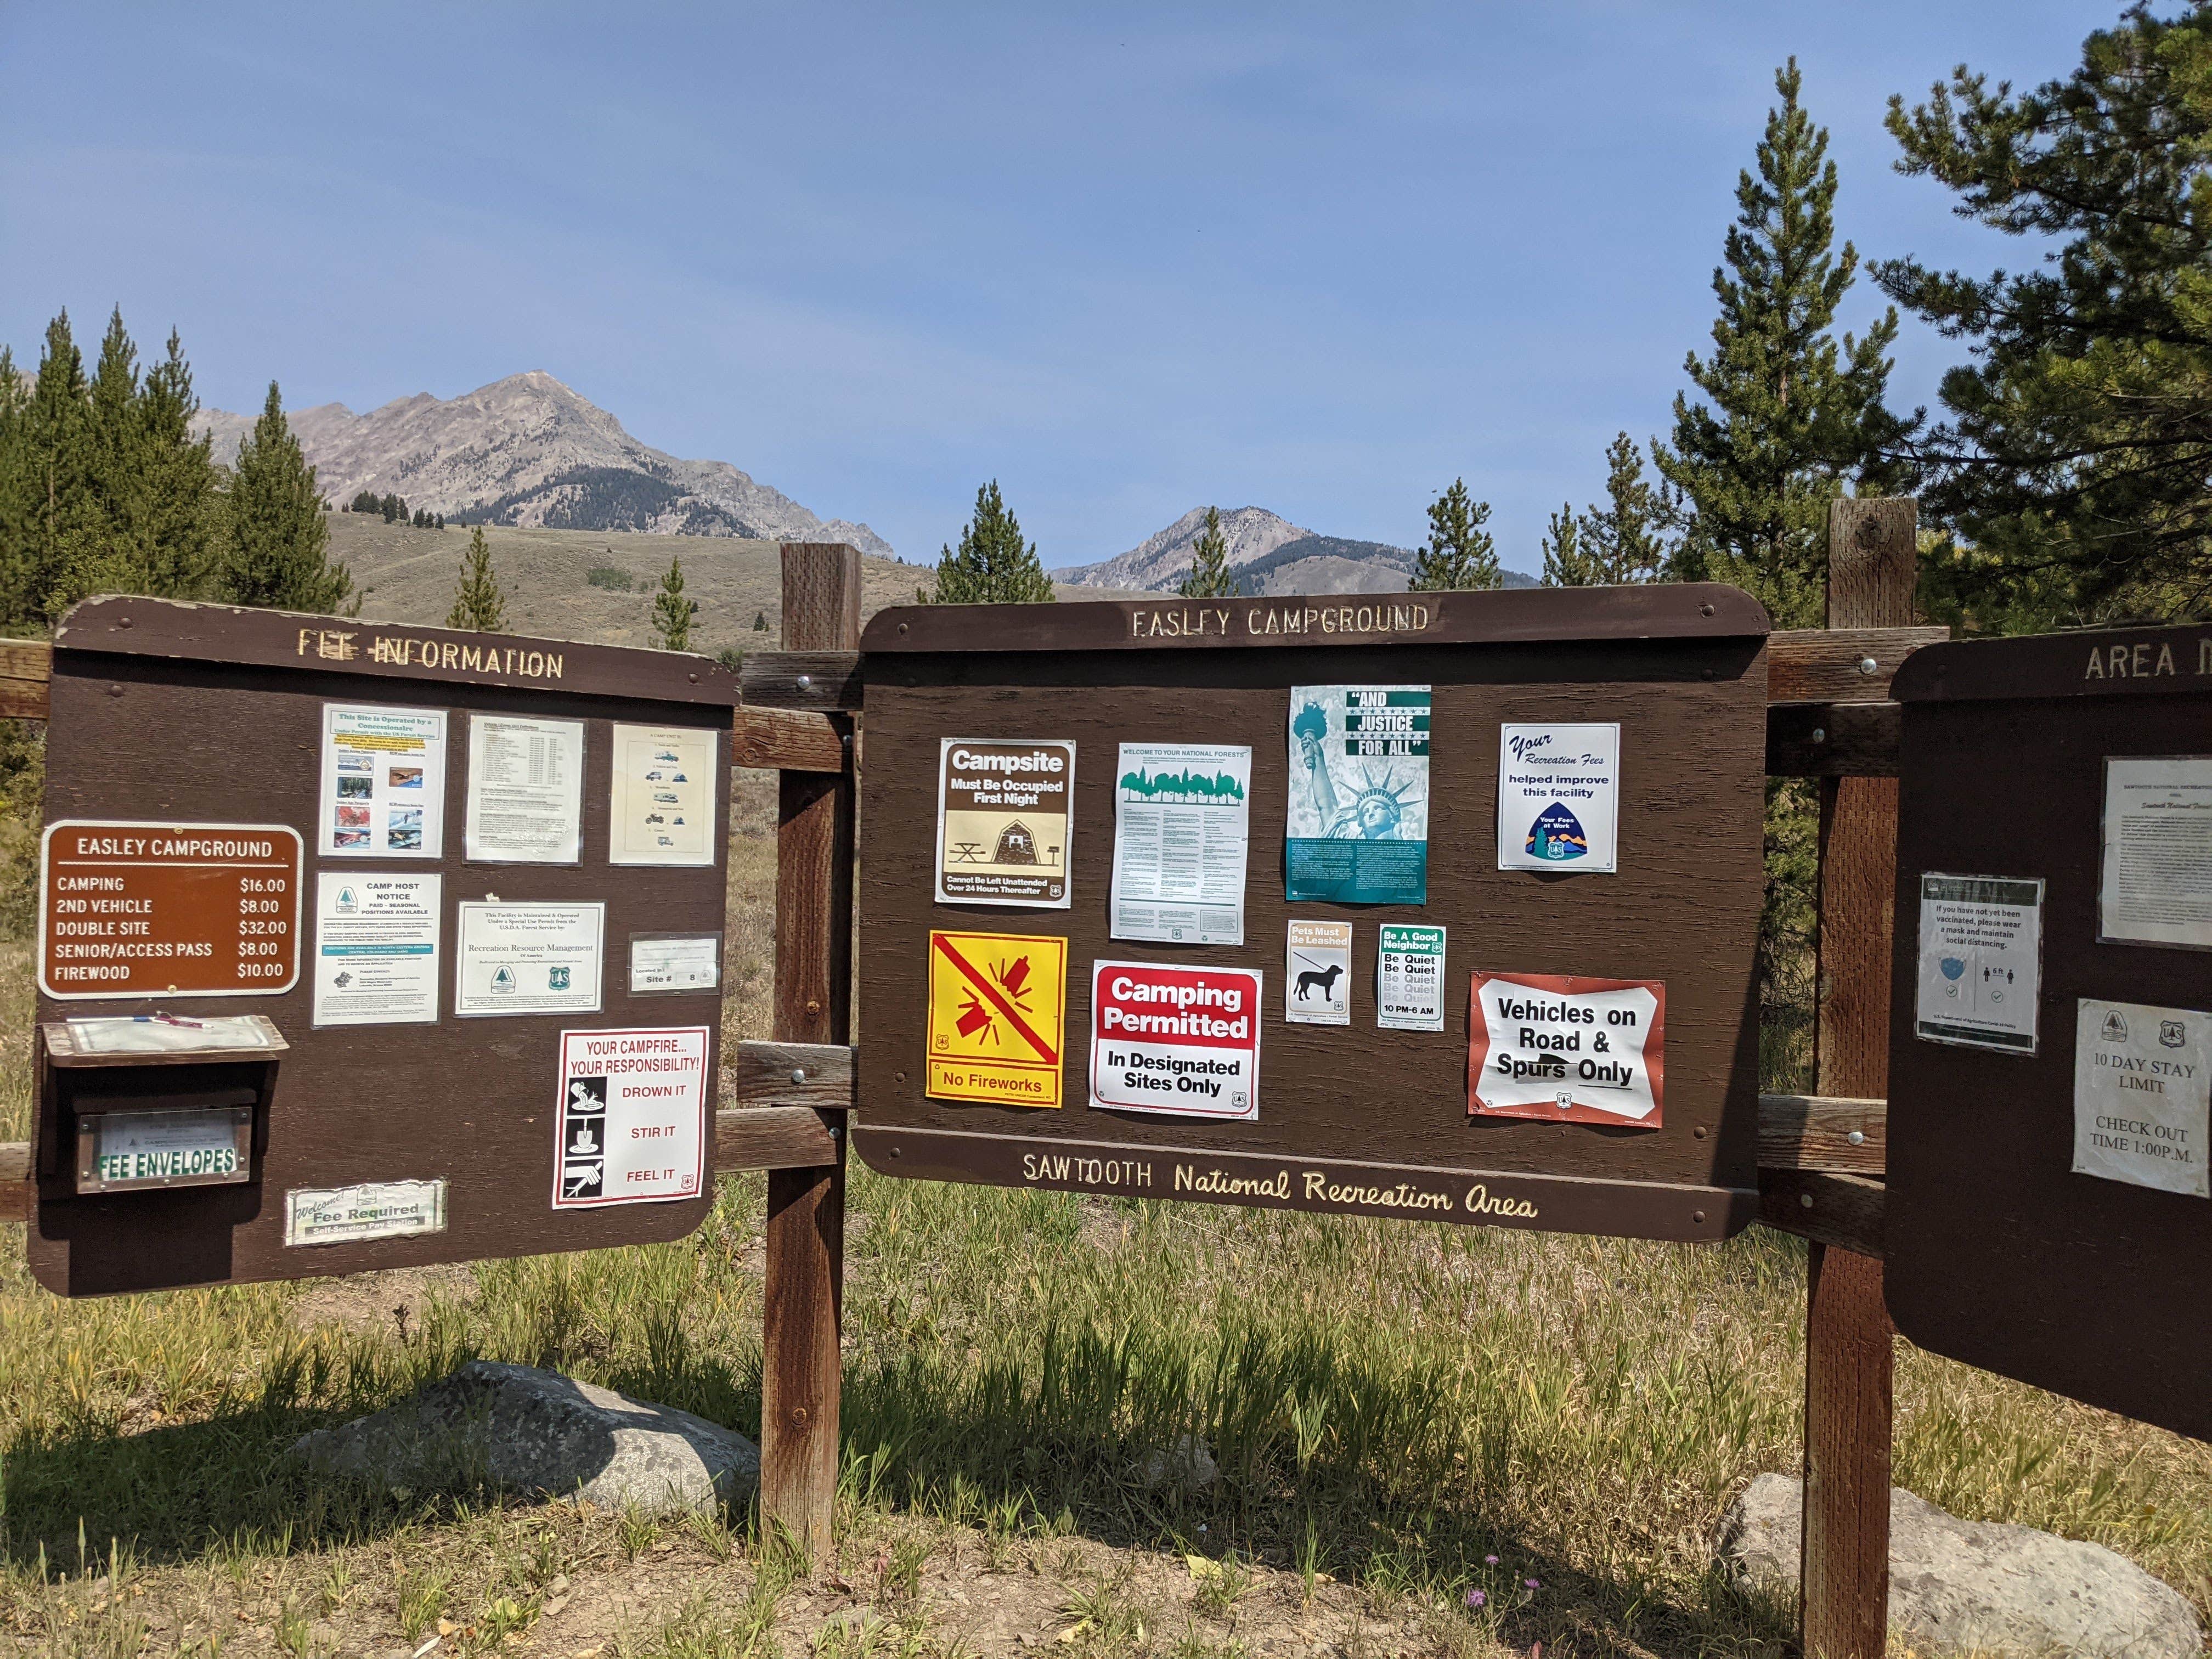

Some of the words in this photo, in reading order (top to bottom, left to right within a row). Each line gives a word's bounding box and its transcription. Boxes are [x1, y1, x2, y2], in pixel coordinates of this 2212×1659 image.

[1133, 608, 1229, 636] EASLEY
[1248, 604, 1427, 635] CAMPGROUND
[299, 629, 358, 659] FEE
[375, 636, 563, 678] INFORMATION
[2085, 643, 2176, 679] AREA
[1358, 716, 1413, 731] JUSTICE
[1358, 741, 1383, 755] FOR
[1509, 733, 1553, 762] Your
[952, 750, 1063, 775] Campsite
[1525, 753, 1577, 764] Recreation
[1581, 754, 1605, 766] Fees
[951, 778, 981, 789] Must
[984, 780, 1001, 790] Be
[1002, 780, 1063, 793] Occupied
[1509, 775, 1553, 785] helped
[1556, 776, 1609, 785] improve
[974, 792, 1002, 803] First
[1004, 793, 1038, 806] Night
[1523, 788, 1547, 796] this
[1550, 788, 1594, 798] facility
[77, 838, 146, 855] EASLEY
[151, 840, 272, 857] CAMPGROUND
[57, 878, 124, 890] CAMPING
[240, 879, 285, 893] $16.00
[57, 900, 87, 913] 2ND
[92, 900, 153, 913] VEHICLE
[239, 900, 279, 914] $8.00
[56, 922, 115, 935] DOUBLE
[120, 922, 150, 935] SITE
[239, 922, 286, 935] $32.00
[1937, 917, 1976, 926] vaccinated,
[1978, 920, 2001, 928] please
[1293, 927, 1313, 935] Pets
[1315, 928, 1339, 936] Must
[1412, 933, 1437, 941] Good
[1967, 928, 1980, 936] and
[1982, 929, 2014, 938] maintain
[547, 944, 592, 952] Management
[1306, 936, 1347, 945] Leashed
[1384, 940, 1430, 950] Neighbor
[1968, 939, 2007, 950] distancing.
[55, 943, 173, 958] SENIOR/ACCESS
[177, 943, 212, 956] PASS
[239, 943, 277, 957] $8.00
[1404, 955, 1435, 964] Quiet
[55, 967, 129, 980] FIREWOOD
[238, 964, 283, 978] $10.00
[1385, 964, 1399, 972] Be
[1404, 965, 1435, 974] Quiet
[1384, 974, 1398, 982] Be
[1404, 974, 1435, 984] Quiet
[1112, 977, 1242, 1012] Camping
[1397, 1006, 1418, 1014] PM-6
[1498, 998, 1594, 1024] Vehicles
[1607, 1009, 1636, 1026] on
[1104, 1007, 1248, 1039] Permitted
[587, 1041, 617, 1055] YOUR
[620, 1040, 687, 1054] CAMPFIRE...
[1520, 1028, 1579, 1051] Road
[1593, 1031, 1610, 1053] &
[571, 1060, 602, 1075] YOUR
[606, 1057, 699, 1073] RESPONSIBILITY!
[1108, 1051, 1125, 1067] In
[1130, 1053, 1240, 1075] Designated
[1497, 1054, 1565, 1079] Spurs
[1578, 1059, 1633, 1086] Only
[2095, 1053, 2107, 1065] 10
[2112, 1056, 2146, 1071] DAY
[2151, 1061, 2195, 1079] STAY
[944, 1072, 963, 1086] No
[969, 1074, 1042, 1092] Fireworks
[1124, 1073, 1172, 1091] Sites
[1177, 1077, 1221, 1097] Only
[2119, 1075, 2165, 1093] LIMIT
[623, 1087, 672, 1098] DROWN
[676, 1086, 686, 1096] IT
[631, 1127, 661, 1138] STIR
[665, 1126, 675, 1137] IT
[2096, 1115, 2151, 1136] CHECK
[2155, 1125, 2188, 1143] OUT
[2090, 1133, 2128, 1150] TIME
[100, 1154, 129, 1180] FEE
[137, 1148, 234, 1176] ENVELOPES
[627, 1170, 659, 1182] FEEL
[664, 1169, 675, 1180] IT
[1023, 1154, 1152, 1187] SAWTOOTH
[1175, 1164, 1290, 1199] National
[1304, 1171, 1453, 1211] Recreation
[1465, 1184, 1537, 1218] Area
[296, 1192, 345, 1219] Welcome!
[313, 1212, 342, 1223] Fee
[348, 1203, 419, 1219] Required
[313, 1223, 366, 1234] Self-Service
